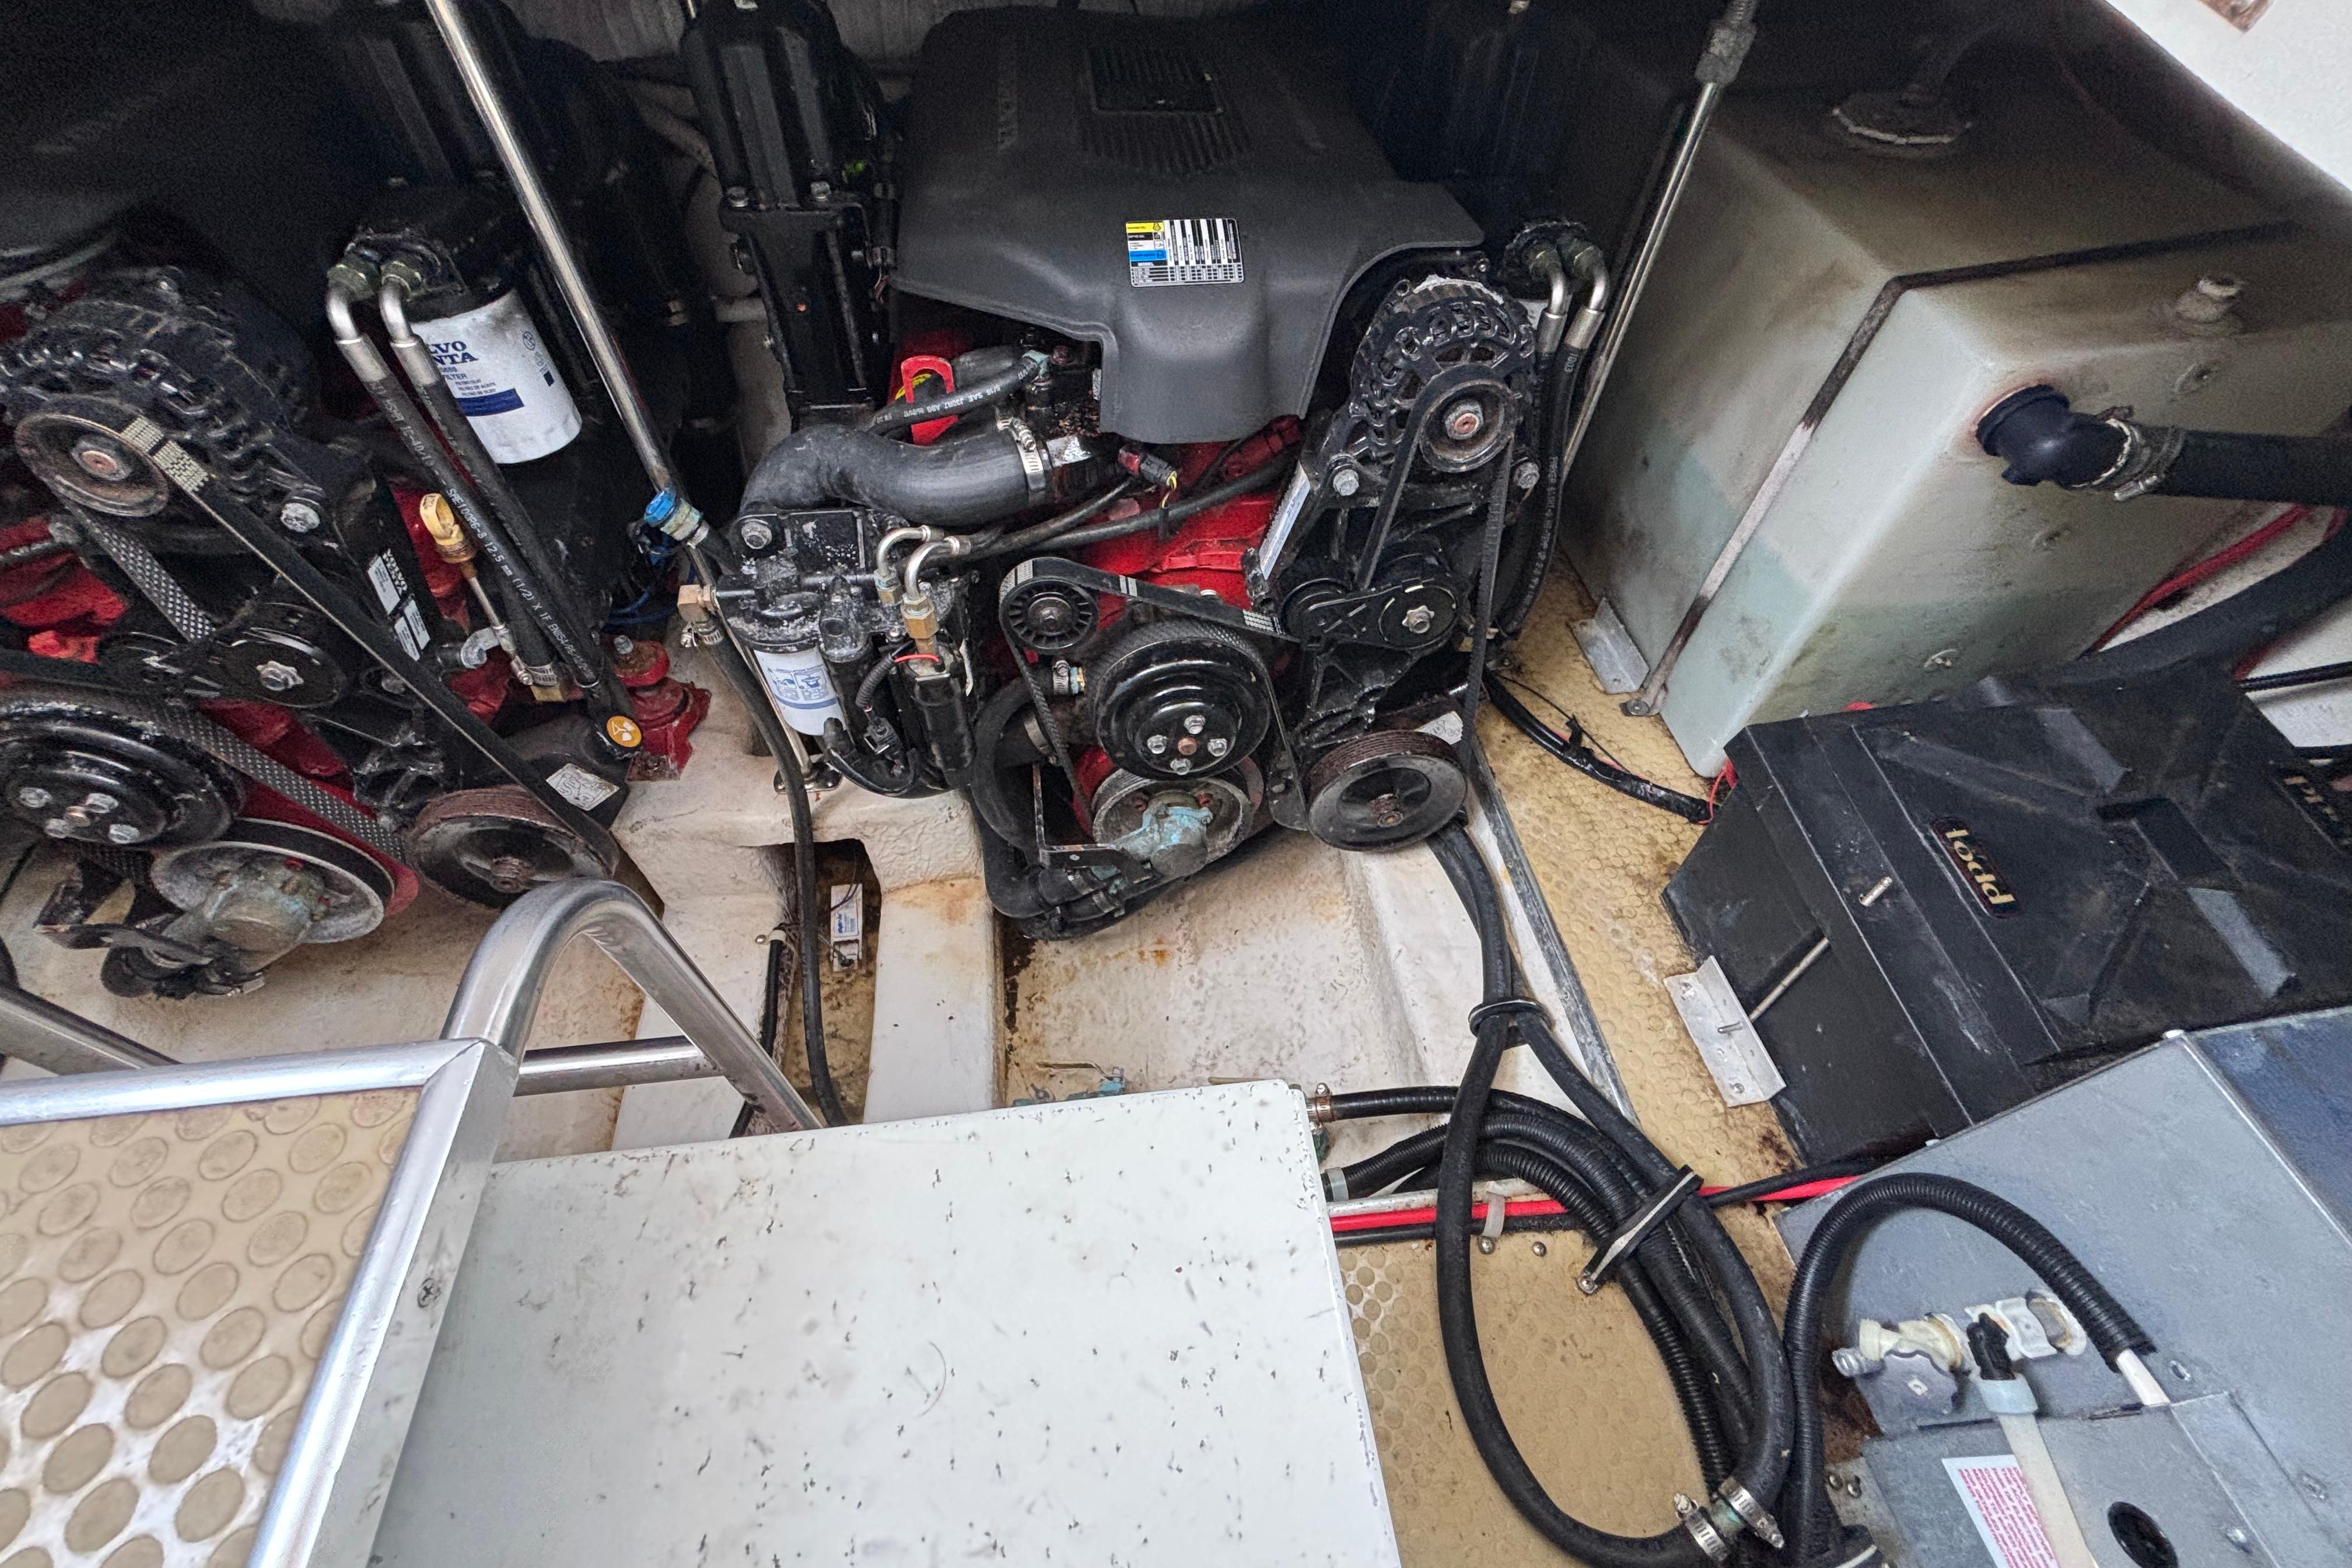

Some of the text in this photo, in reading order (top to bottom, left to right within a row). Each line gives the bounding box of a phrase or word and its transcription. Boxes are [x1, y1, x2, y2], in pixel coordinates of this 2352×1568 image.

[968, 392, 984, 403] SAE
[446, 488, 488, 540] SAE100R6-8
[485, 541, 506, 563] 12.5
[512, 578, 535, 601] (1/2)
[1945, 828, 2017, 904] todd
[1957, 1469, 1976, 1497] REFER
[1973, 1500, 1984, 1511] TO
[1964, 1469, 1977, 1486] FOR
[1974, 1489, 2000, 1530] DETAILED
[1971, 1468, 1992, 1500] MEANS
[1989, 1502, 1999, 1514] TO
[1997, 1516, 2017, 1547] WATER
[1983, 1468, 2010, 1510] CONNECT
[2008, 1514, 2033, 1553] BRANCH
[1991, 1468, 2007, 1489] RISK
[2004, 1491, 2014, 1503] OF
[2011, 1505, 2040, 1550] ELECTRIC
[2010, 1488, 2035, 1524] ACCESS
[2031, 1526, 2054, 1560] COVER
